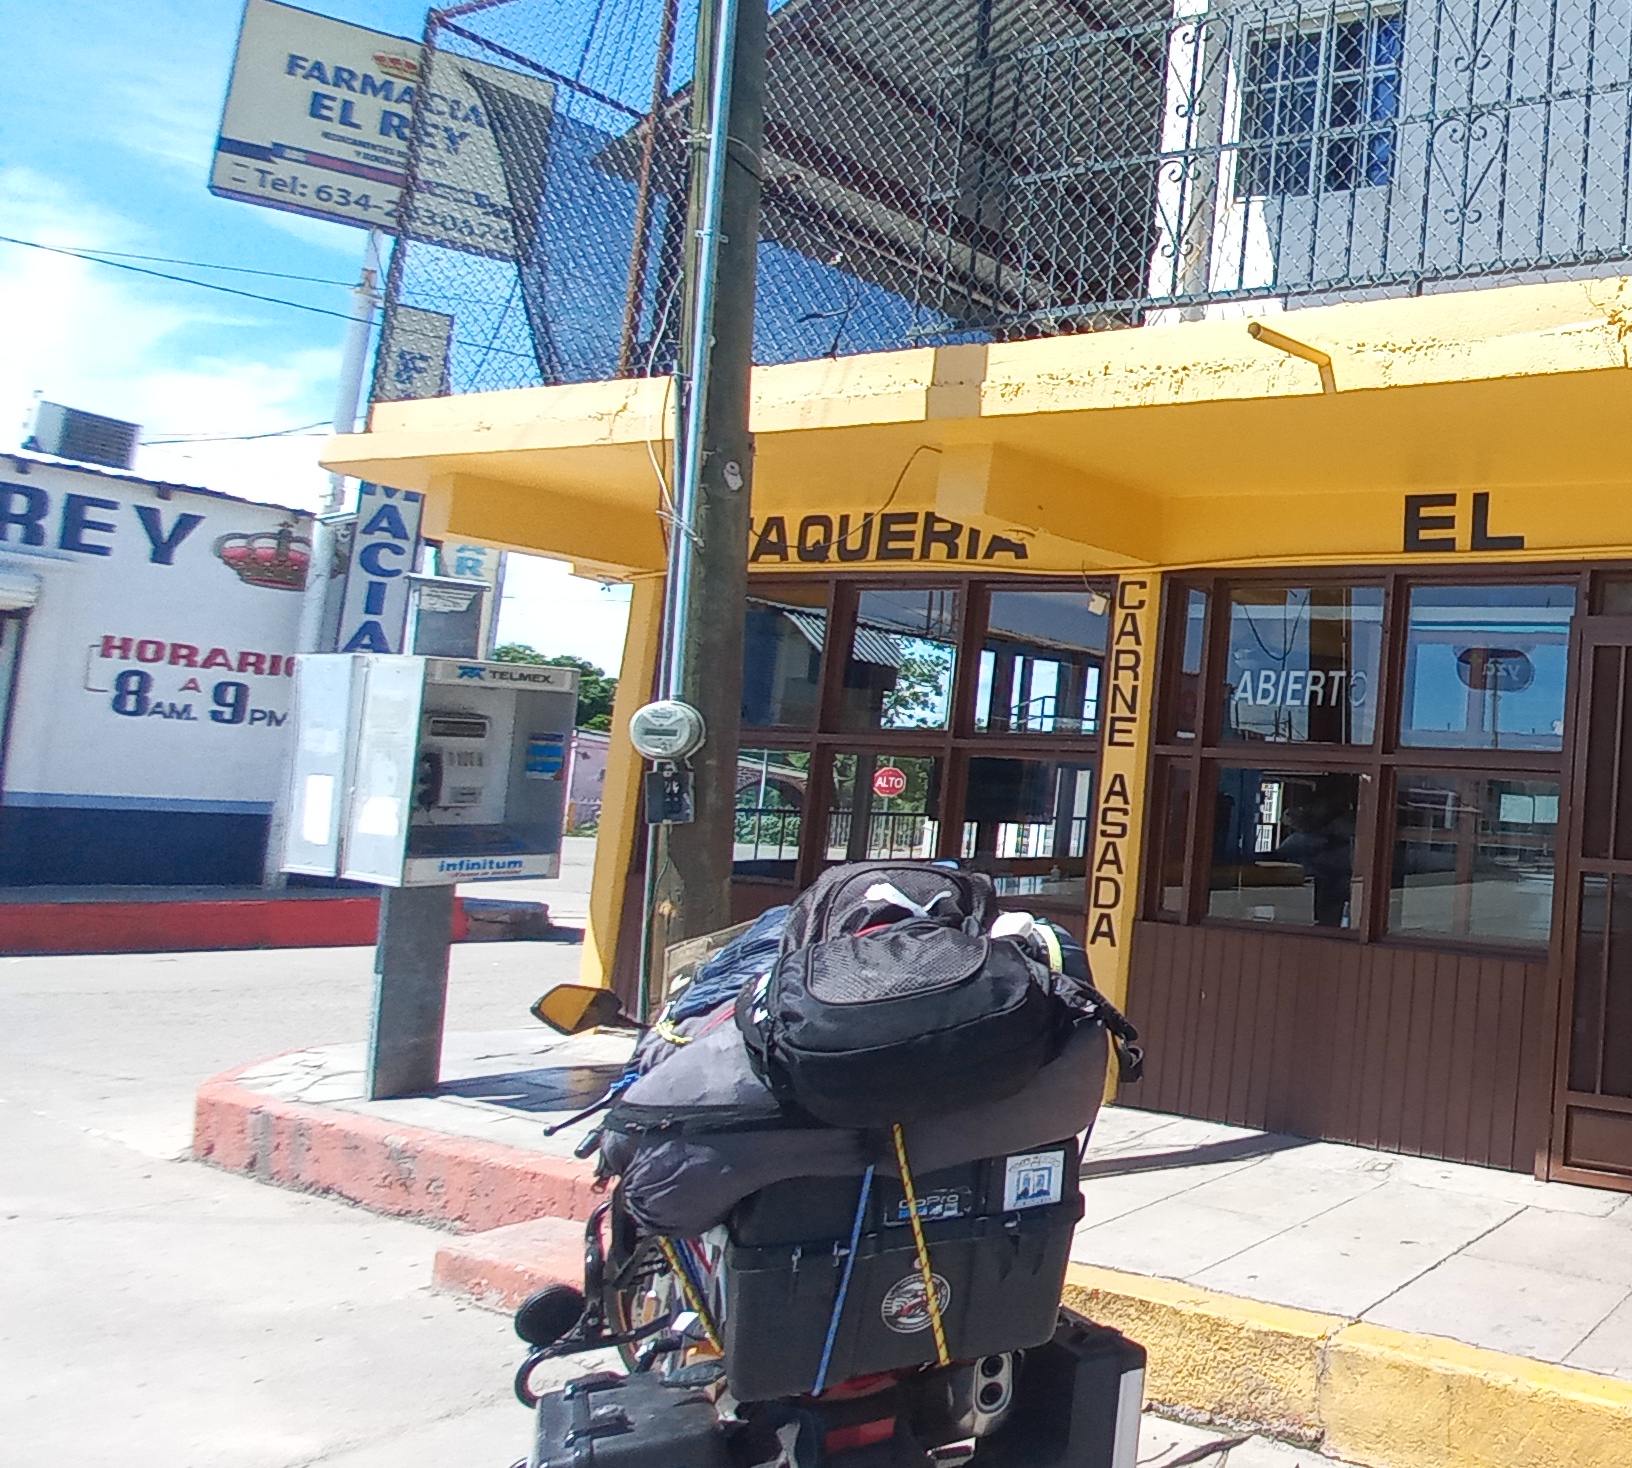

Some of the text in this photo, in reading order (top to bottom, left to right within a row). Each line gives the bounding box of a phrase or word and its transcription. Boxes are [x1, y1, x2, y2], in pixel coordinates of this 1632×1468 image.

[285, 53, 487, 129] FARMACIA
[309, 90, 362, 130] EL
[379, 109, 470, 156] REY
[254, 167, 307, 198] Tel:
[0, 482, 206, 565] REY
[750, 510, 1029, 563] AQUERIA
[1404, 491, 1525, 552] EL
[179, 677, 202, 693] A
[489, 670, 554, 684] TELMEX
[1232, 669, 1368, 707] ABIERTO
[875, 776, 903, 788] ALTO
[1090, 580, 1148, 948] CARNE ASADA
[438, 859, 524, 872] infinitum
